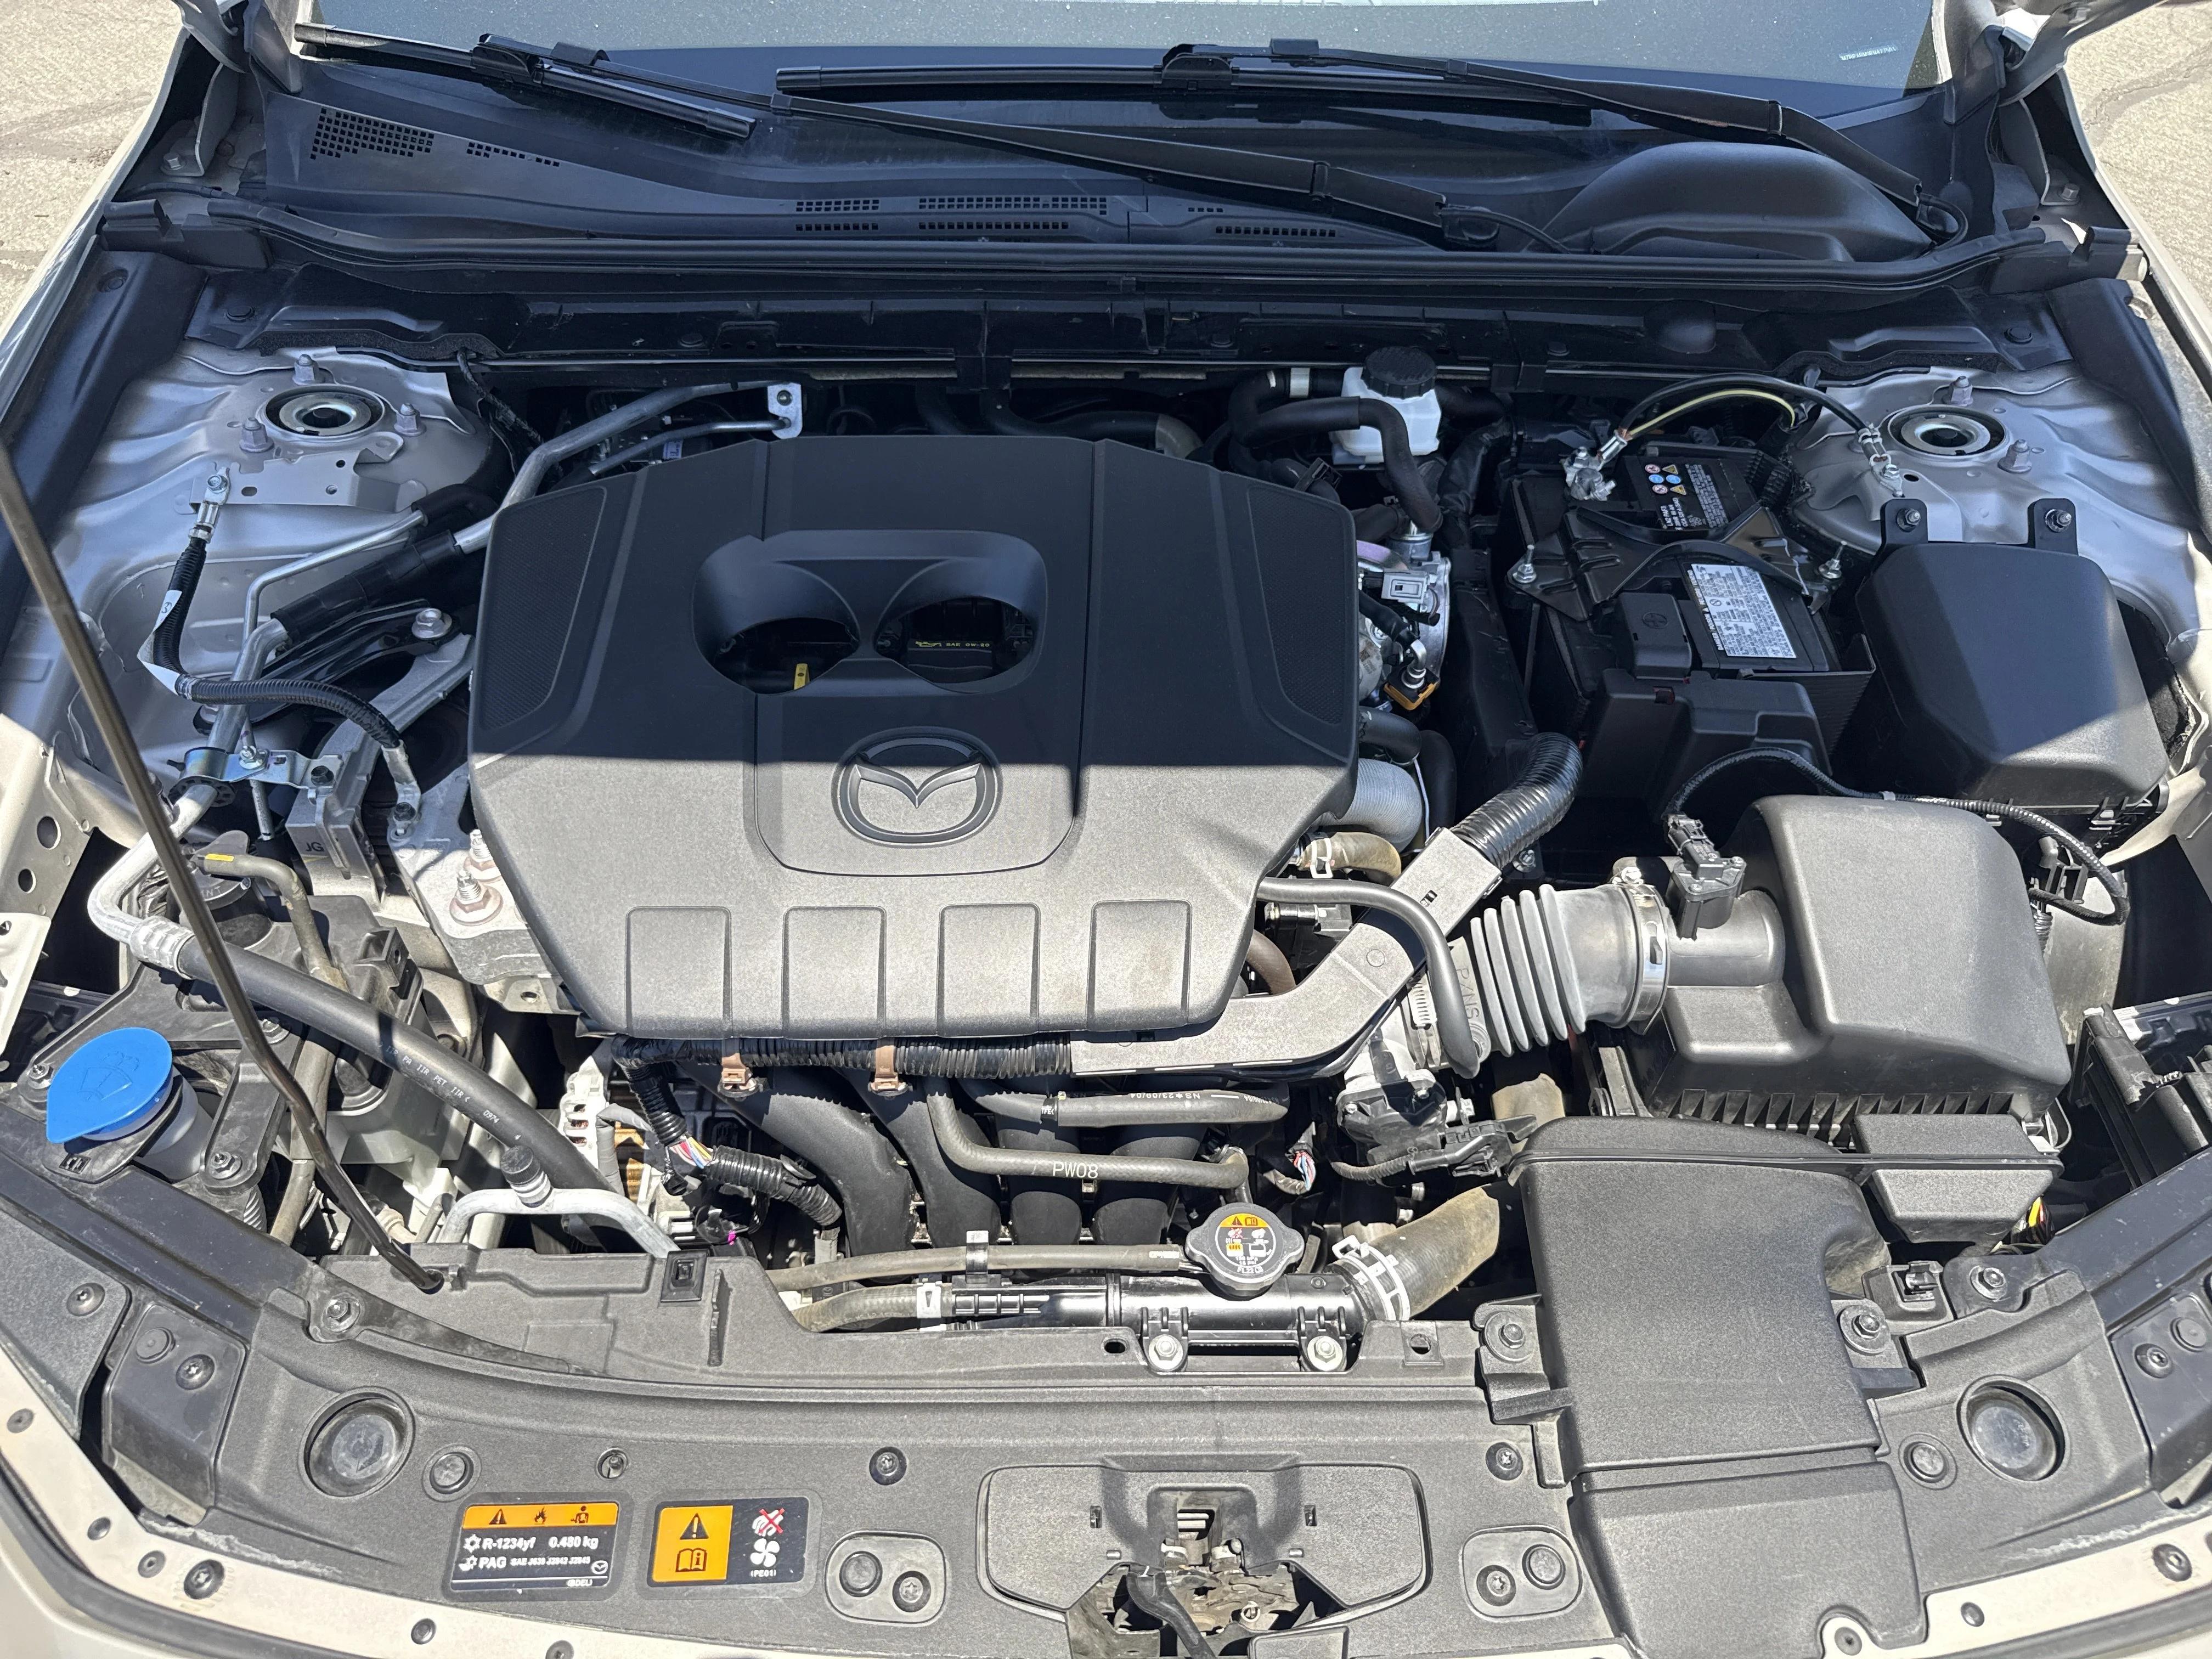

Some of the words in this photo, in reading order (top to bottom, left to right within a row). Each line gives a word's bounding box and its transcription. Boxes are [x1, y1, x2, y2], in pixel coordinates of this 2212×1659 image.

[306, 842, 325, 852] JG
[433, 1075, 448, 1086] PET
[482, 1537, 537, 1552] R-1234yf
[549, 1536, 582, 1548] 0.480
[583, 1536, 599, 1550] kg
[478, 1556, 507, 1569] PAG
[510, 1557, 528, 1566] SAE
[751, 1569, 777, 1577] (PE01)
